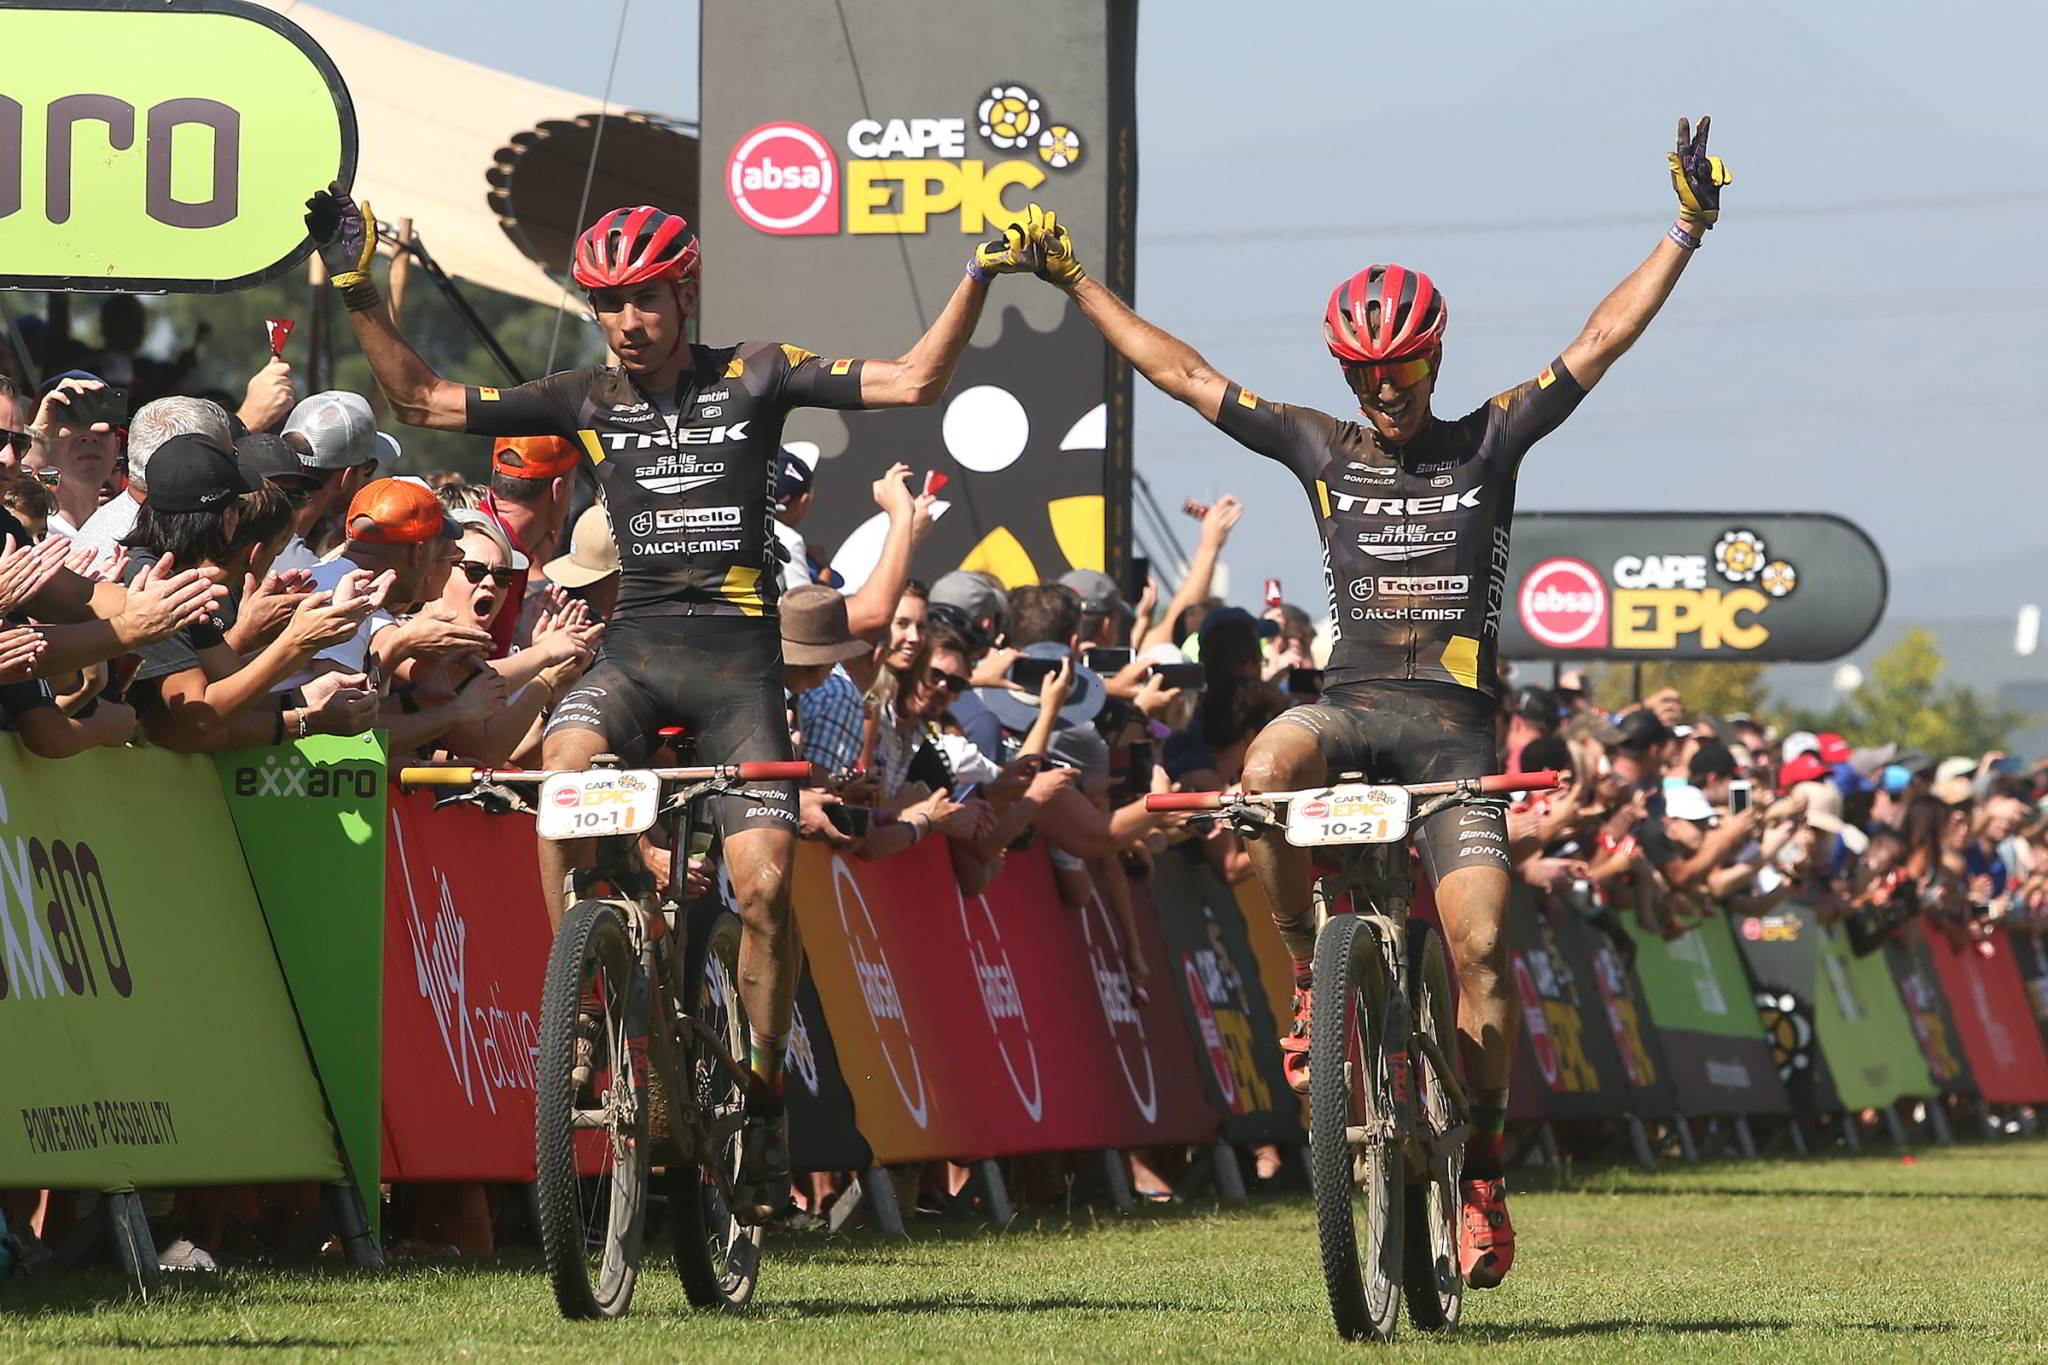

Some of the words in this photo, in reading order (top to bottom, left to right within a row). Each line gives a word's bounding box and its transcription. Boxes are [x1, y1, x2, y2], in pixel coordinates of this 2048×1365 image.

[846, 118, 965, 159] CAPE
[0, 93, 241, 229] ro
[743, 157, 821, 190] absa
[846, 159, 1047, 235] EPIC
[602, 420, 749, 450] TREK
[657, 453, 698, 466] selle
[1342, 474, 1397, 486] BONTRAGER
[1331, 485, 1483, 516] TREK
[660, 512, 736, 524] Tonello
[1382, 524, 1428, 534] selle
[644, 539, 742, 554] ALCHEMIST
[1613, 555, 1707, 590] CAPE
[1382, 580, 1465, 592] Tonello
[1531, 584, 1594, 615] absa
[1365, 608, 1466, 620] ALCHEMIST
[1613, 588, 1770, 650] EPIC
[235, 756, 377, 798] exxaro
[584, 781, 616, 791] CAPE
[583, 789, 636, 807] EPIC
[1333, 796, 1364, 804] CAPE
[1332, 803, 1386, 817] EPIC
[573, 810, 619, 829] 10-1
[1321, 822, 1373, 836] 10-2
[1459, 830, 1504, 843] Santini
[19, 1107, 98, 1154] POWERING
[94, 1100, 179, 1146] POSSIBILITY
